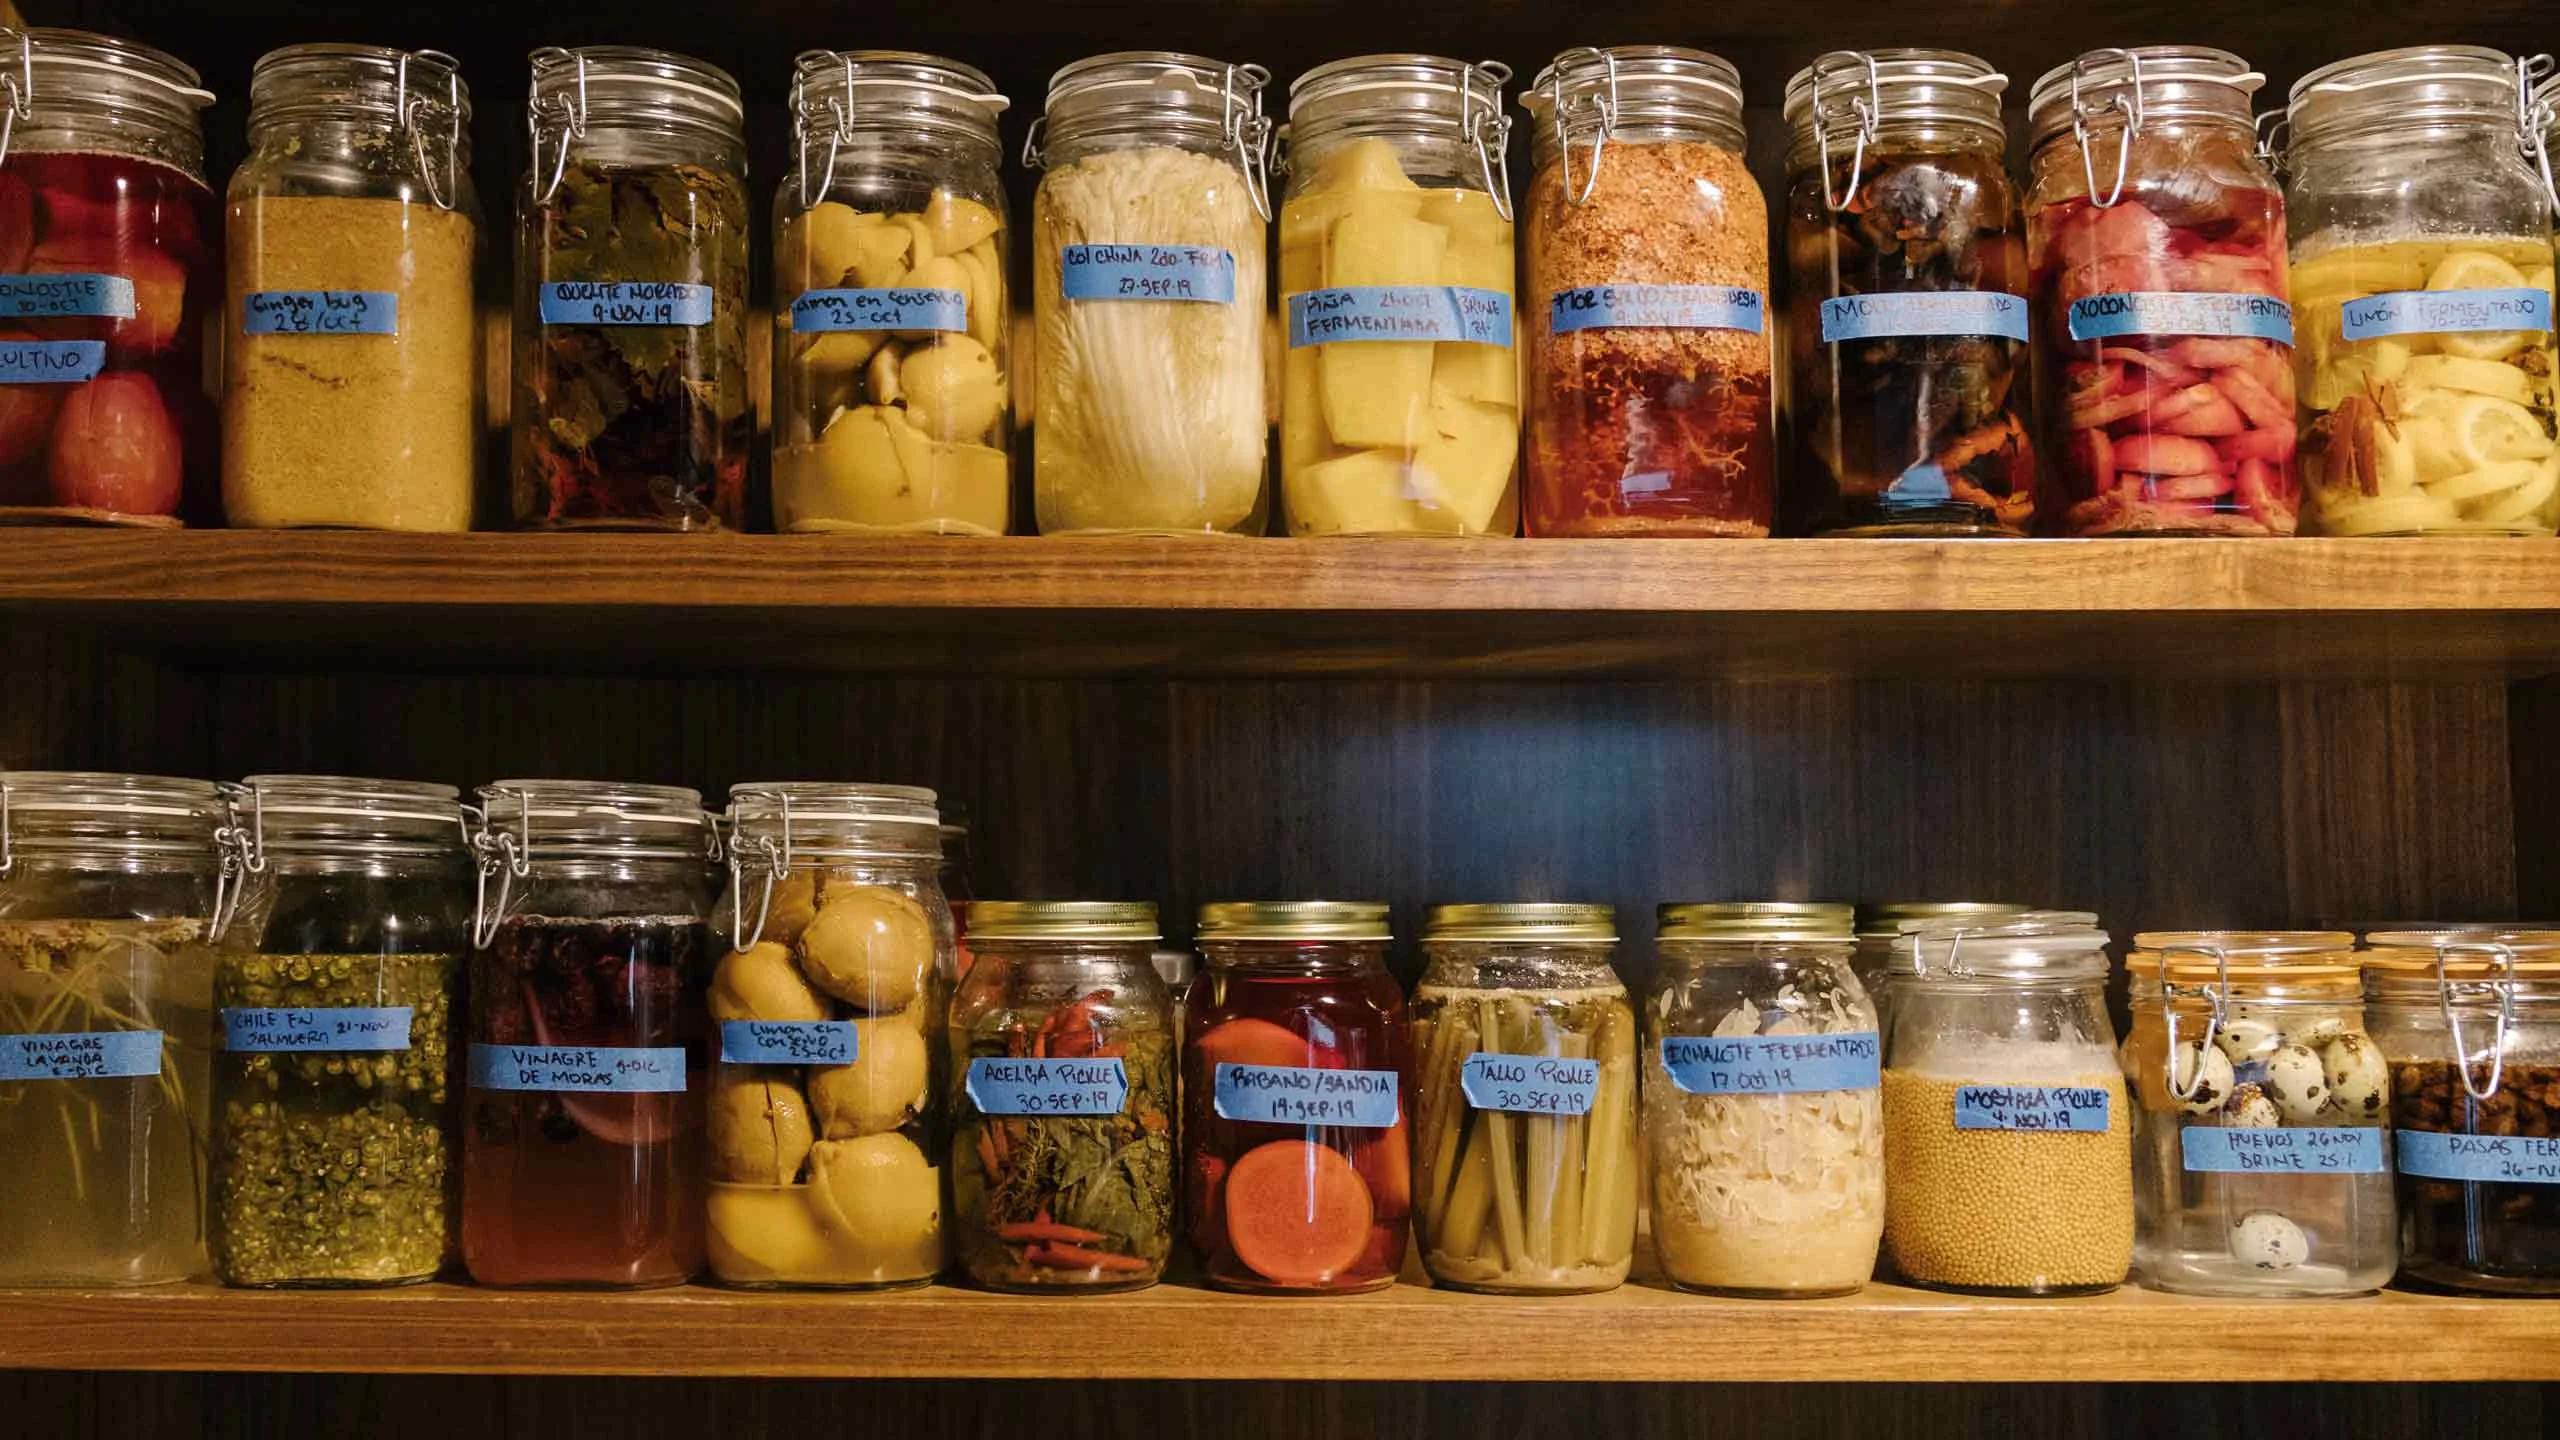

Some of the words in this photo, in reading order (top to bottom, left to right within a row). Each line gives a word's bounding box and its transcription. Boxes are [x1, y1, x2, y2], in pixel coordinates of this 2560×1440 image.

[323, 291, 366, 311] bug
[855, 295, 882, 308] en
[1306, 292, 1356, 314] PIÑA
[236, 1012, 277, 1030] CHILE
[287, 1012, 314, 1030] EN
[22, 1037, 103, 1052] VINAGRE
[512, 1049, 598, 1068] VINAGRE
[519, 1070, 541, 1085] DE
[551, 1070, 613, 1087] MORAS
[984, 1063, 1049, 1087] ACELGA
[1055, 1064, 1113, 1086] PICKLE
[1471, 1059, 1527, 1083] TALLO
[2227, 1131, 2294, 1151] HUEVOS
[2449, 1137, 2513, 1156] PASAS
[2238, 1152, 2303, 1169] BRINE
